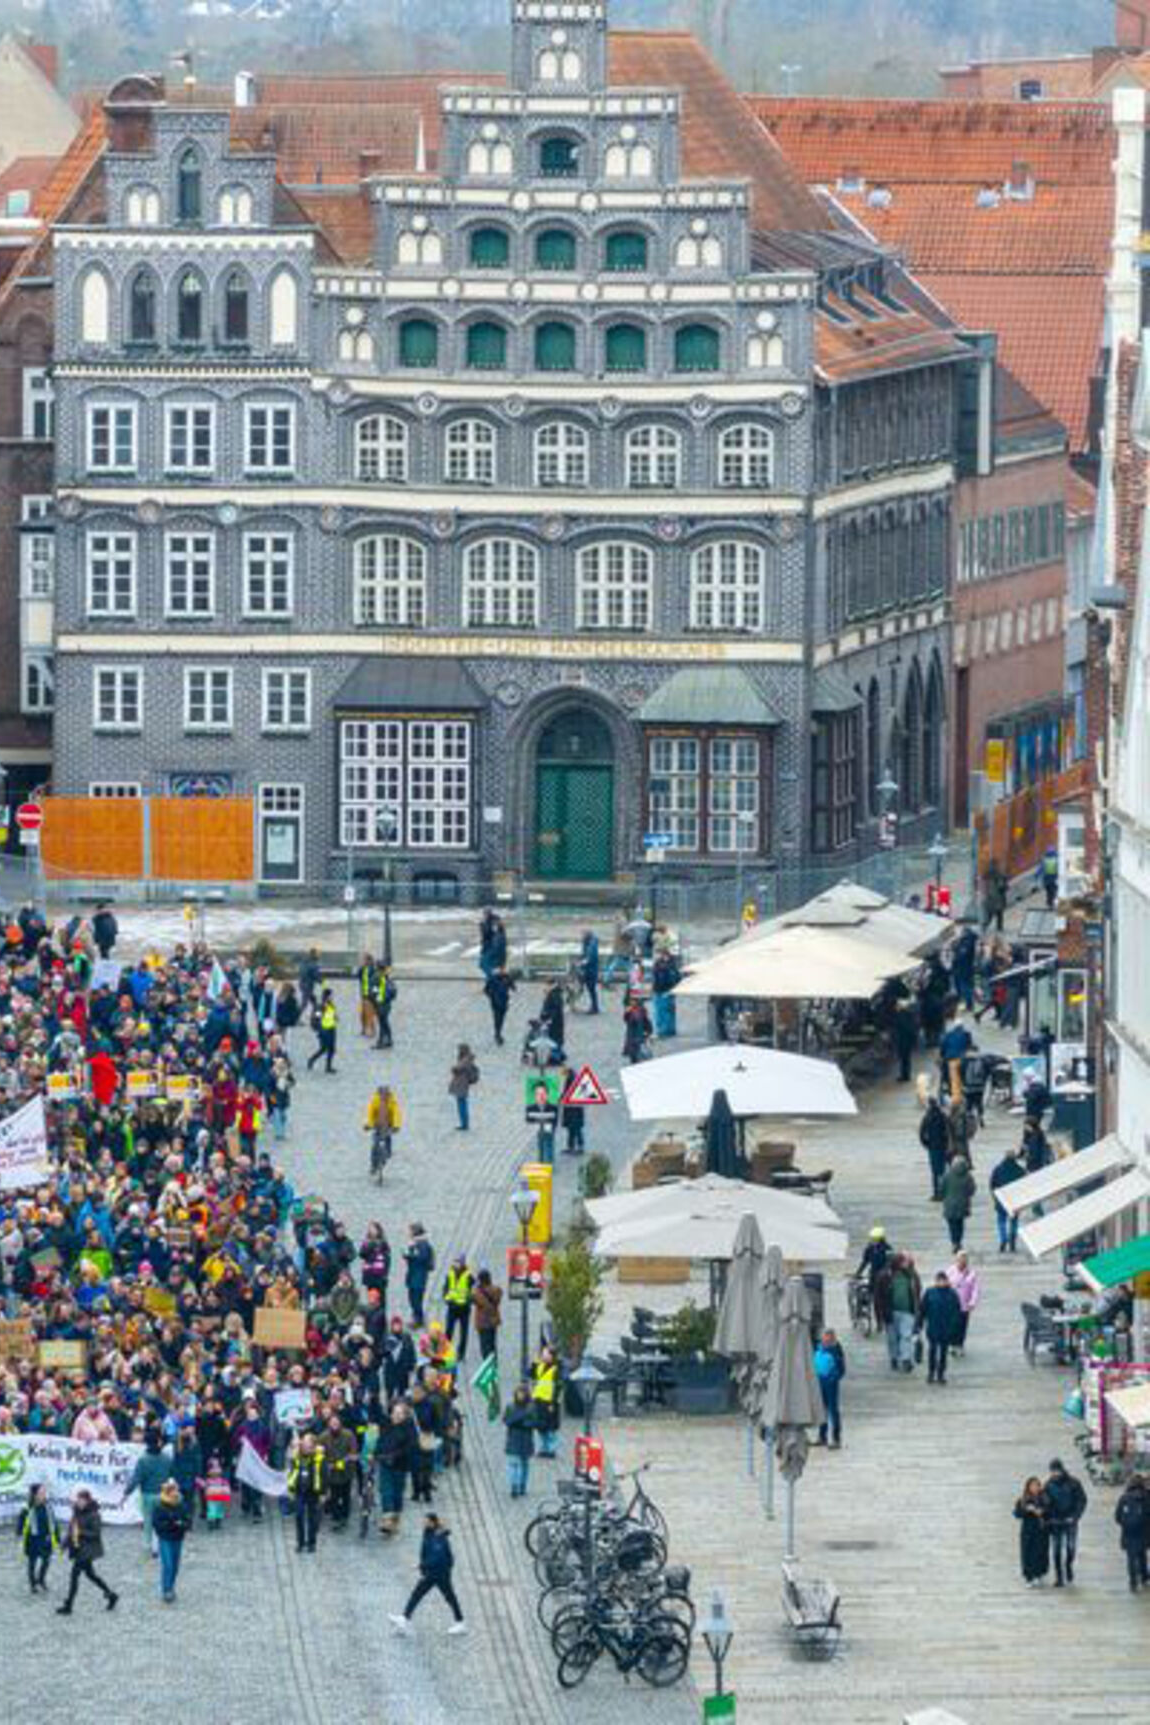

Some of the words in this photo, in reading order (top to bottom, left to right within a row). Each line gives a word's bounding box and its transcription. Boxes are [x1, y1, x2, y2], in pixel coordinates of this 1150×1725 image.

[28, 1443, 62, 1459] Kein
[66, 1445, 104, 1464] Platz
[109, 1447, 129, 1467] für
[57, 1467, 109, 1485] rechtes
